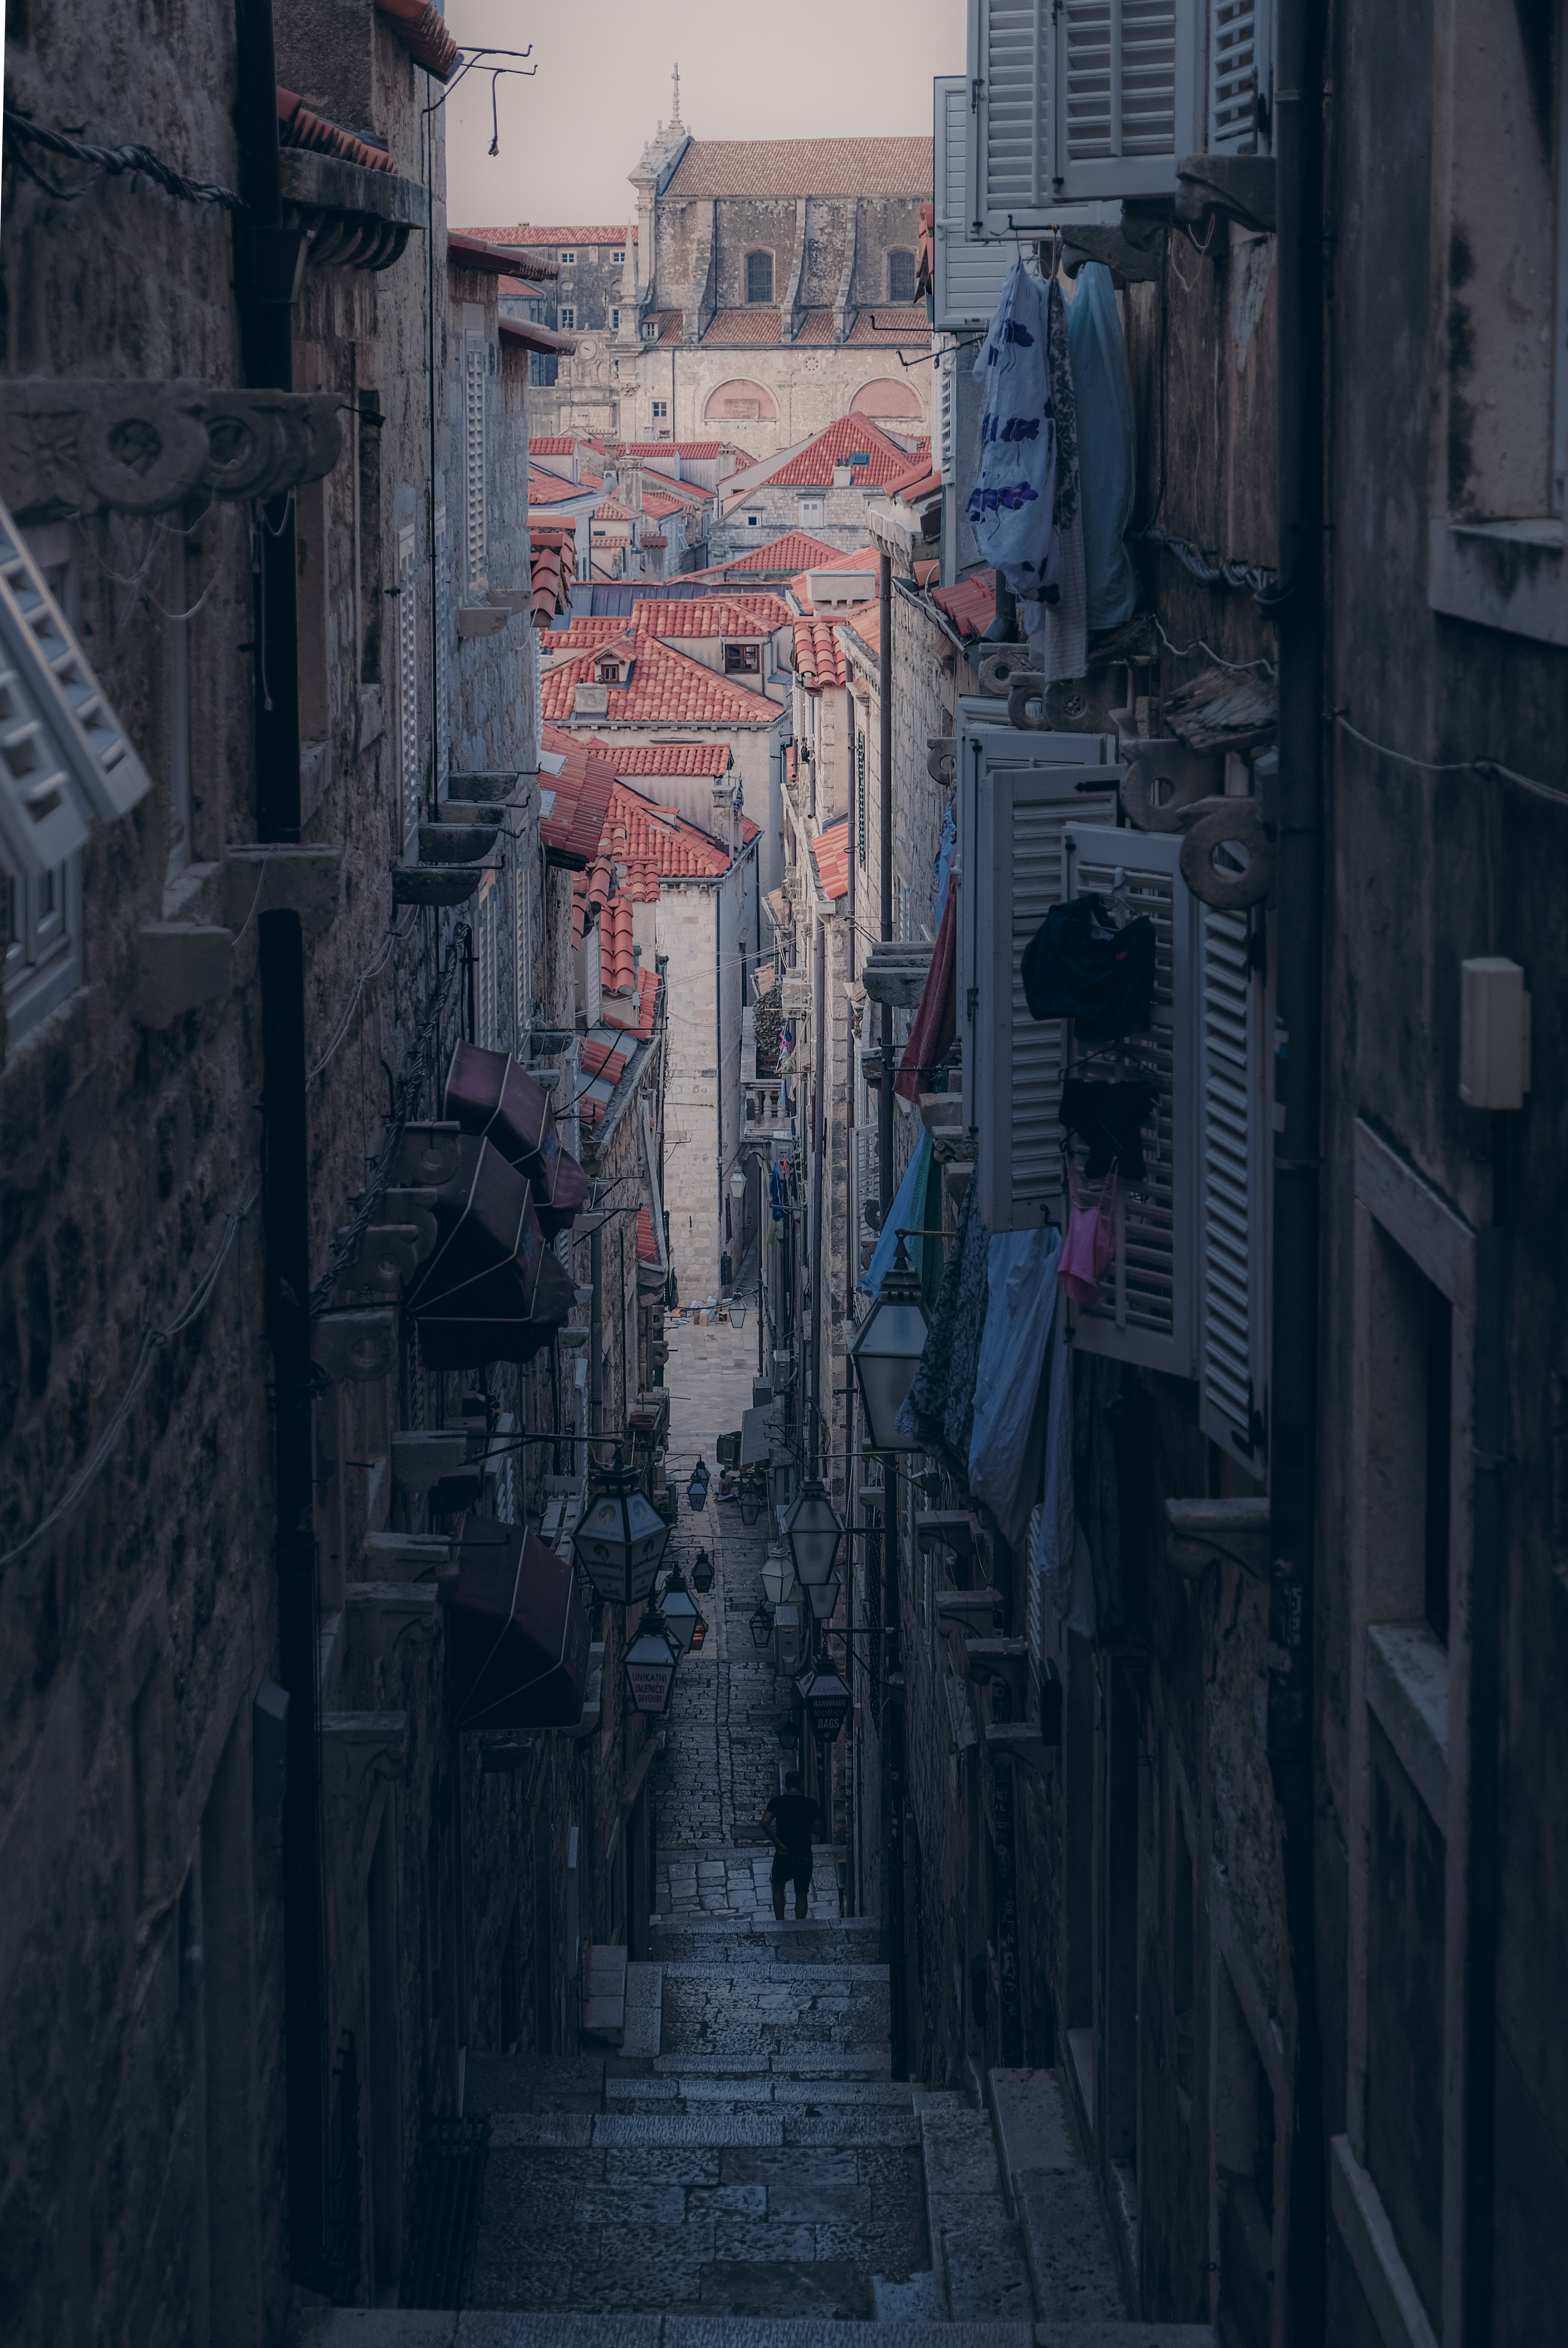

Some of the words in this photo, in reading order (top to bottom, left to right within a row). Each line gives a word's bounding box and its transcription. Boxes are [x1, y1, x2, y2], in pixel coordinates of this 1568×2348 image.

[592, 1573, 624, 1582] APARTMENTS
[633, 1673, 666, 1682] UNIKATNI
[635, 1683, 664, 1693] UMJETNIČKI
[638, 1695, 662, 1703] SUVENIRI
[814, 1708, 843, 1716] leather
[818, 1718, 840, 1729] BAGS
